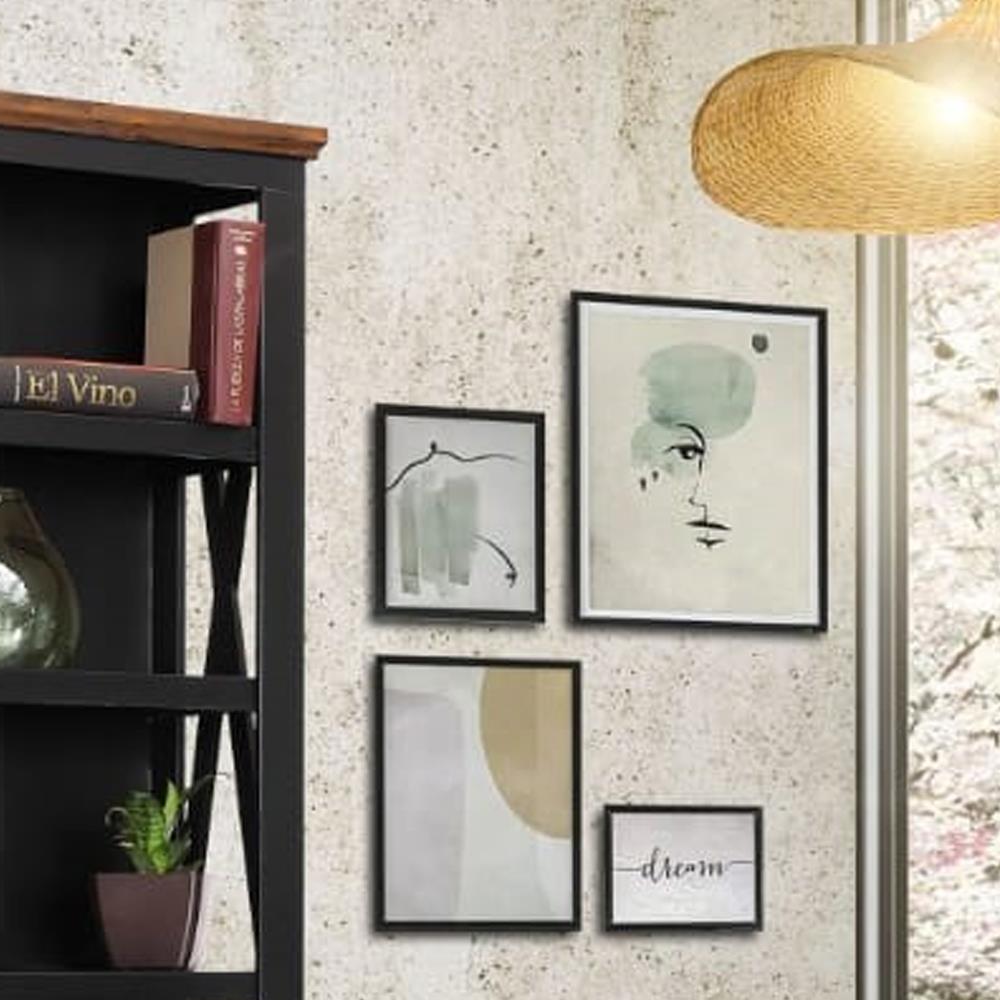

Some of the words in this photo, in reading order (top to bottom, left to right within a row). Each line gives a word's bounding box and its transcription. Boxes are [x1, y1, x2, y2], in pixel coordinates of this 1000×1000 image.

[26, 369, 59, 402] El
[66, 371, 137, 407] Vino
[640, 845, 724, 885] dream
